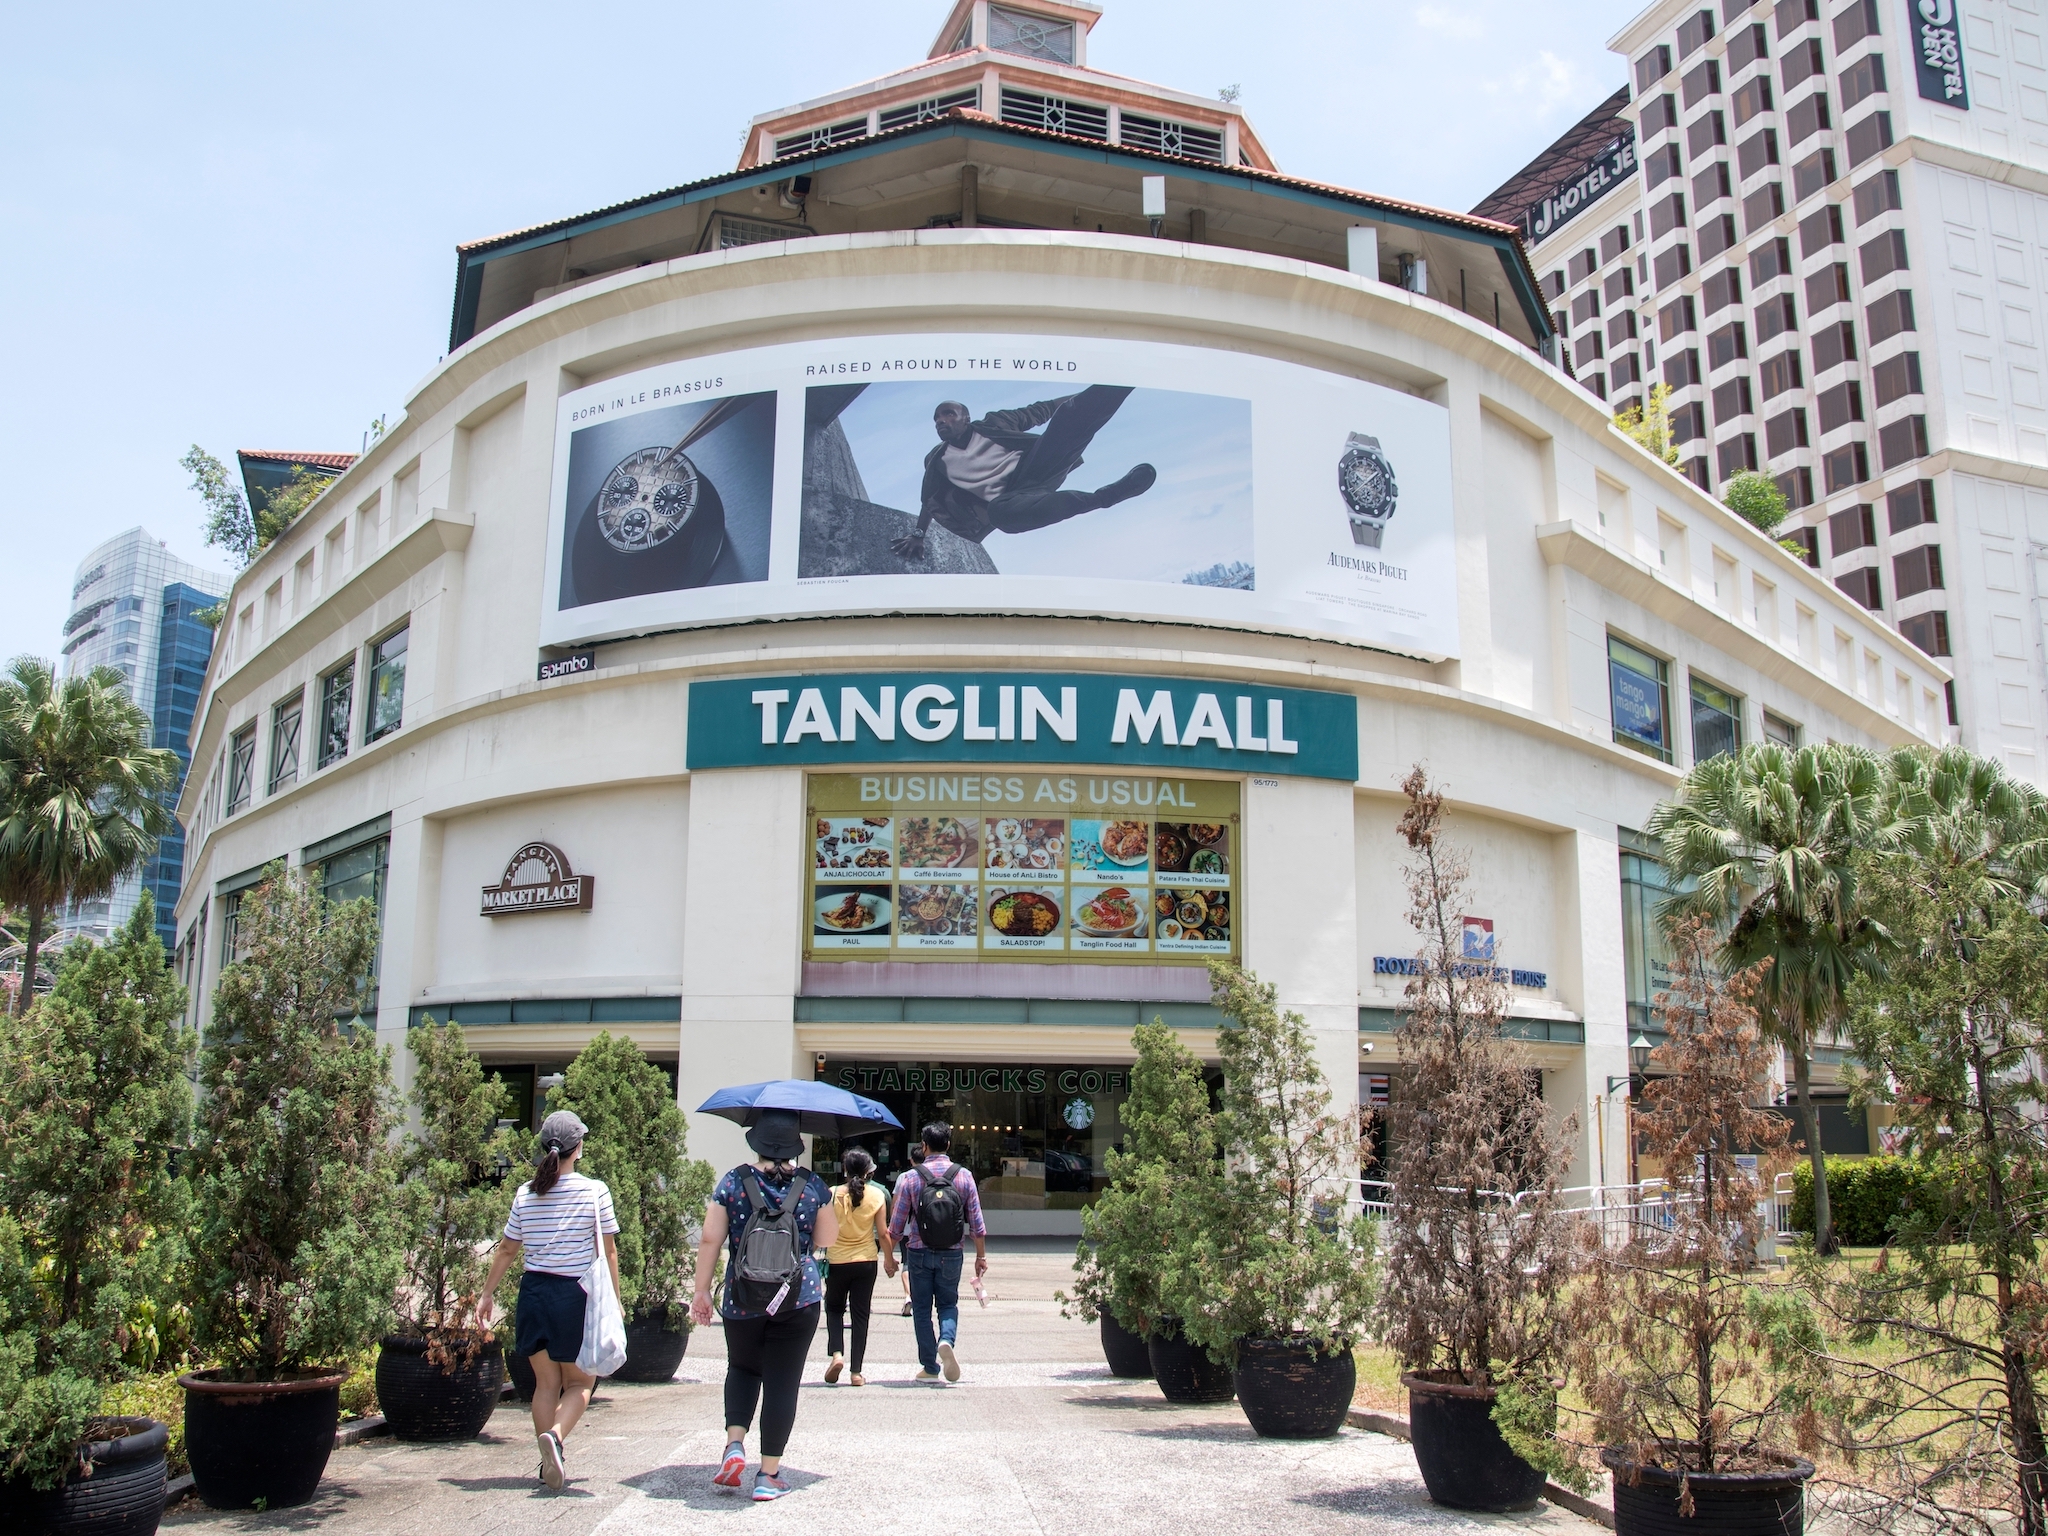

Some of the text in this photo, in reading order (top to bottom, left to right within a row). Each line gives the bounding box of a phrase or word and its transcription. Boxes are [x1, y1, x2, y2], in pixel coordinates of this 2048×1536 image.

[1921, 24, 1943, 68] JEN
[1940, 28, 1963, 100] HOTEL
[1553, 165, 1612, 220] HOTEL
[806, 358, 1078, 376] RAISED AROUND THE WORLD
[572, 377, 723, 422] BORN IN LE BRASSUS
[1327, 552, 1408, 580] AUDEMARS PIGUET
[1619, 677, 1644, 702] tango
[751, 683, 1298, 755] TANGLIN MALL
[1616, 694, 1644, 720] mango
[860, 776, 1197, 808] BUSINESS AS USUAL
[504, 848, 557, 882] TANGLIN
[1080, 941, 1104, 949] Tanglin
[1512, 969, 1547, 988] HOUSE
[838, 1067, 1046, 1094] STARBUCKS
